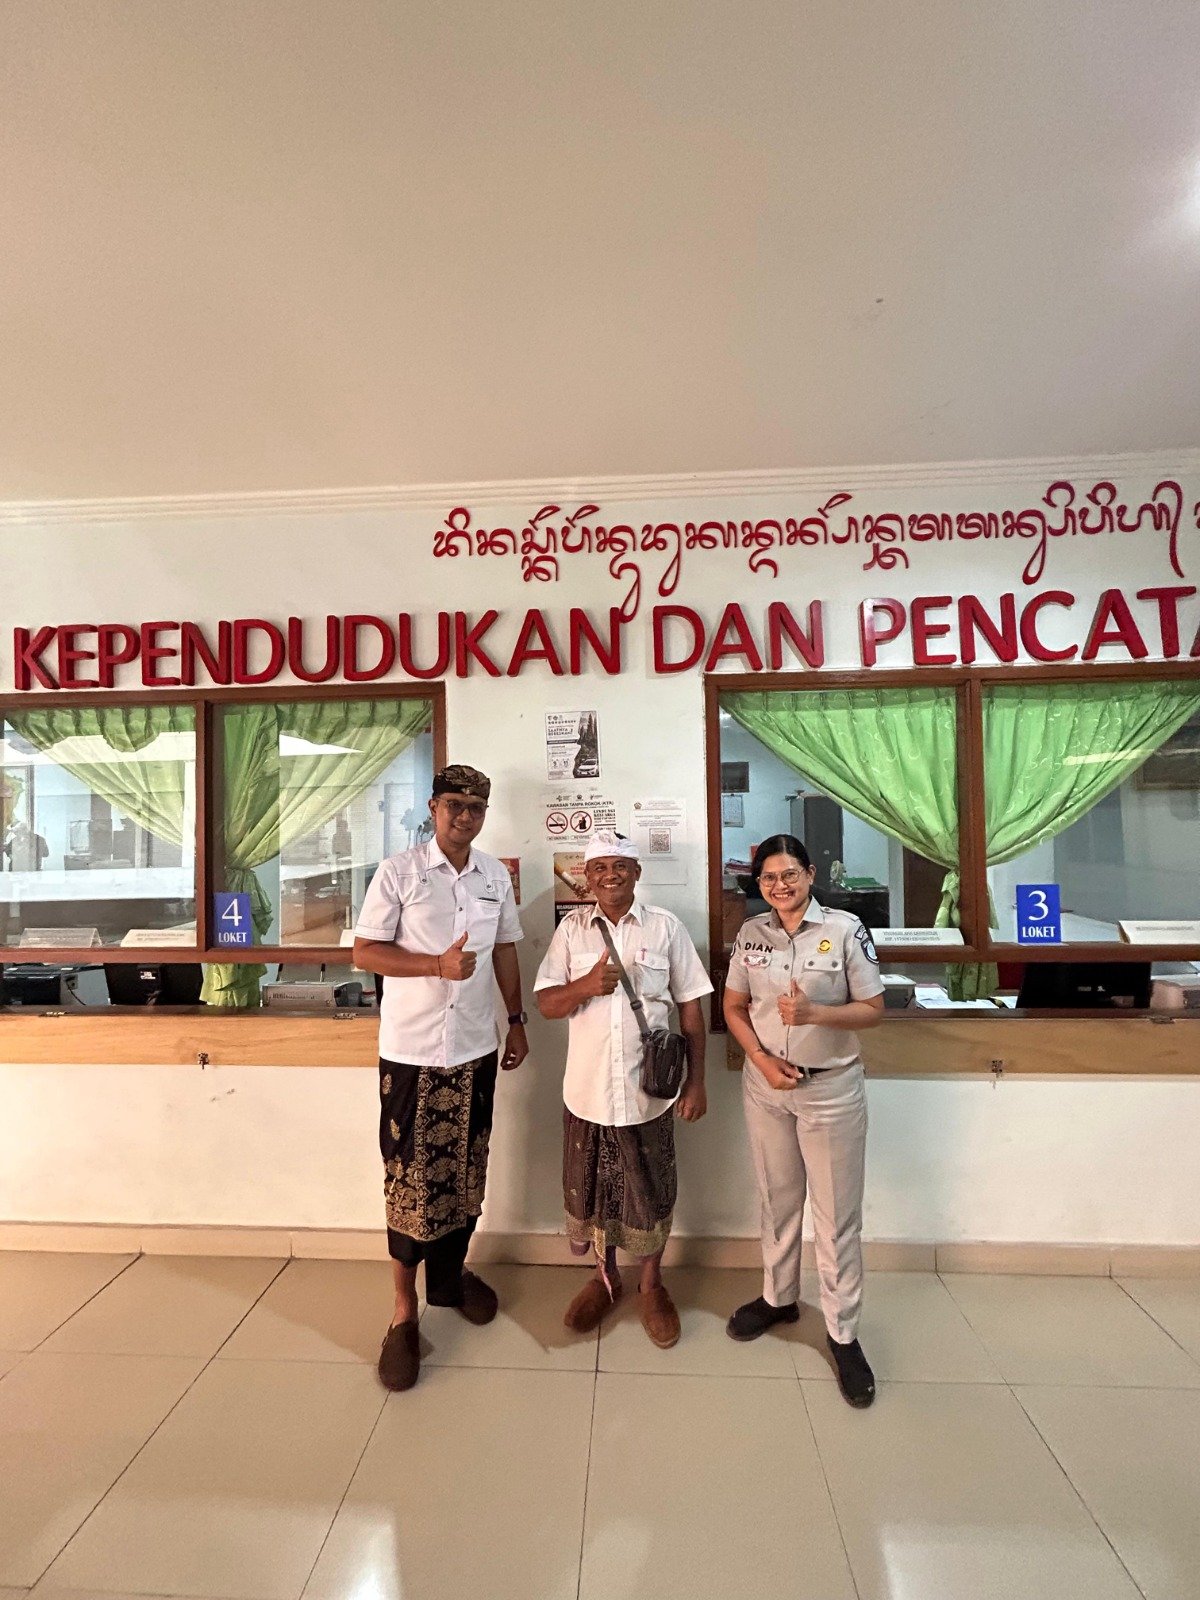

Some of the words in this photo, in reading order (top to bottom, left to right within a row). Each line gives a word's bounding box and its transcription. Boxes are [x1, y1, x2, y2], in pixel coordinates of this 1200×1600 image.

[14, 607, 620, 690] KEPENDUDUKAN
[653, 601, 824, 674] DAN
[860, 587, 1200, 669] PENCAT
[221, 898, 243, 927] 4
[1028, 890, 1049, 921] 3
[218, 932, 247, 943] LOKET
[1022, 926, 1056, 938] LOKET
[744, 942, 774, 953] DIAN
